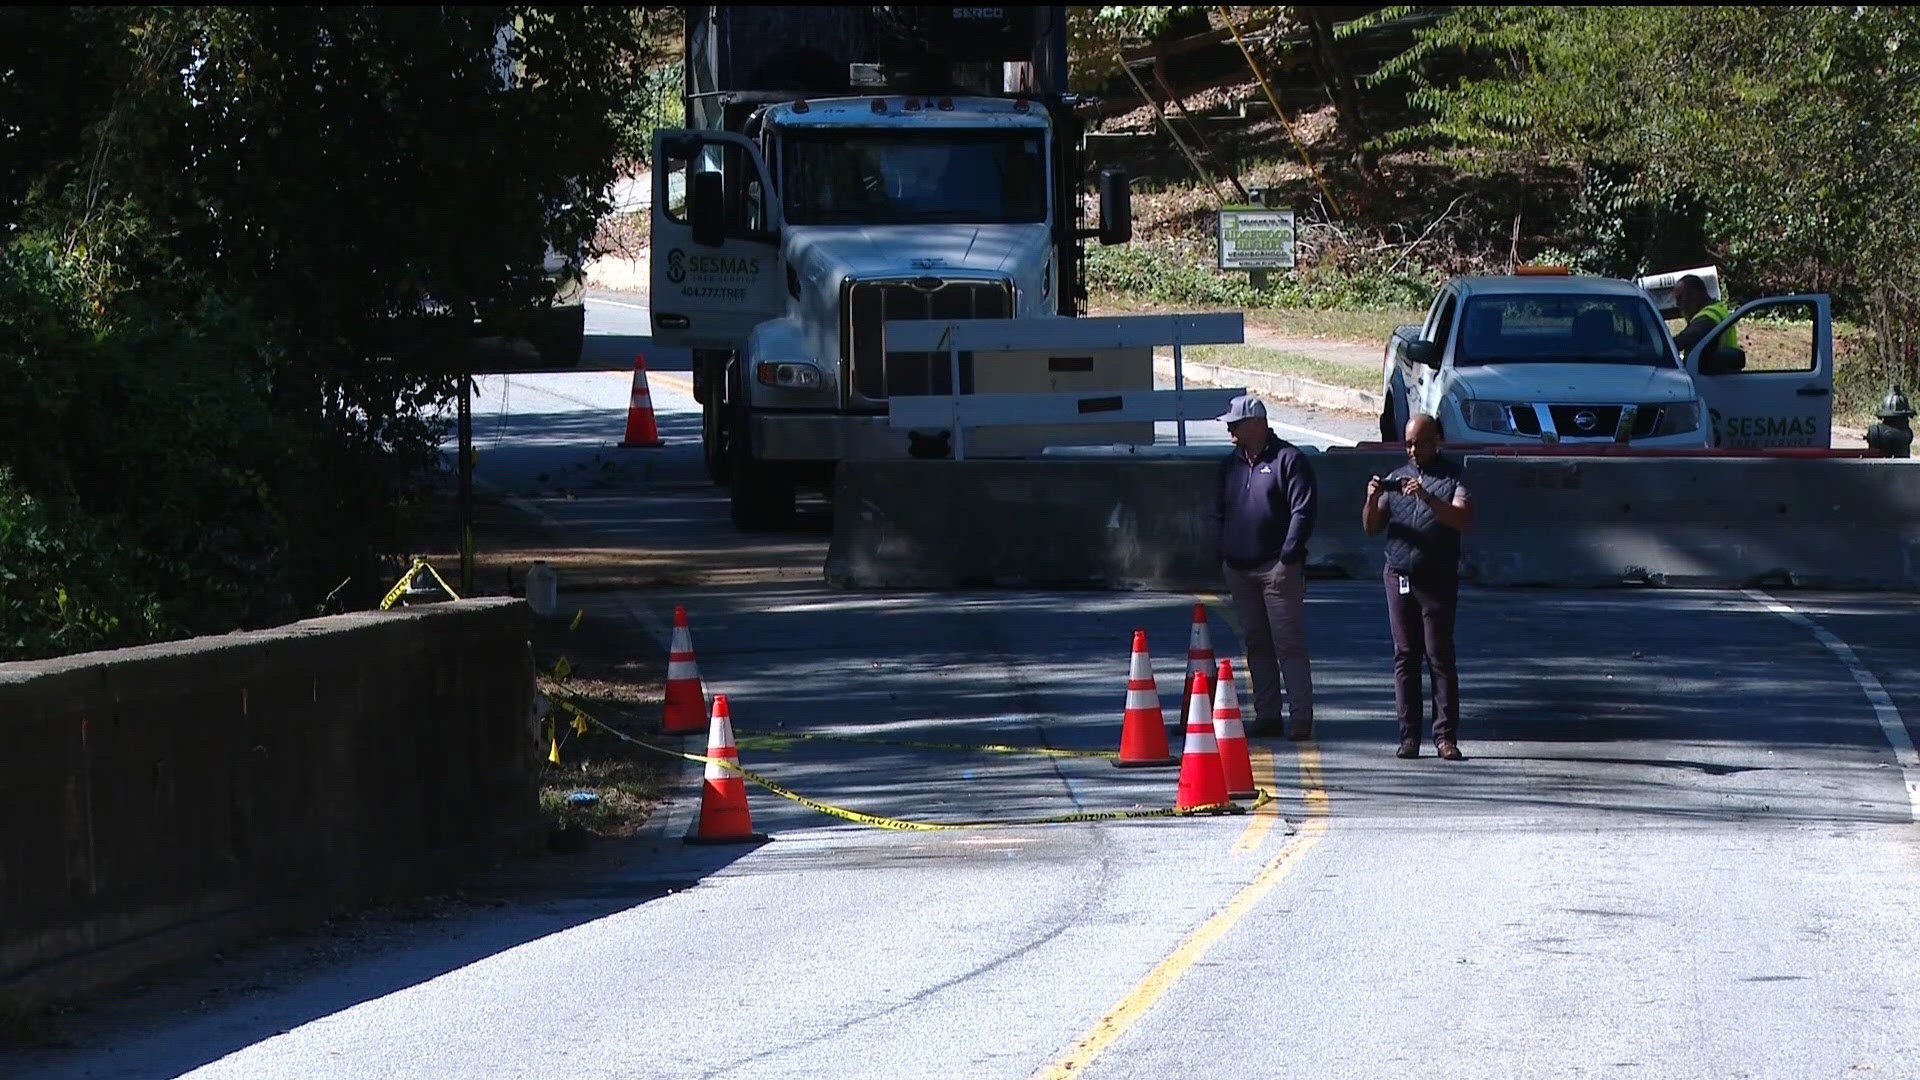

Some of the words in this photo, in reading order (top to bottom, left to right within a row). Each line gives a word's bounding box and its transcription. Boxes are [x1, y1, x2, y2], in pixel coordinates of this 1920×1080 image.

[952, 7, 1003, 18] SERCO
[689, 255, 760, 275] SESMAS
[1726, 415, 1817, 437] SESMAS
[859, 814, 920, 831] CAUTION
